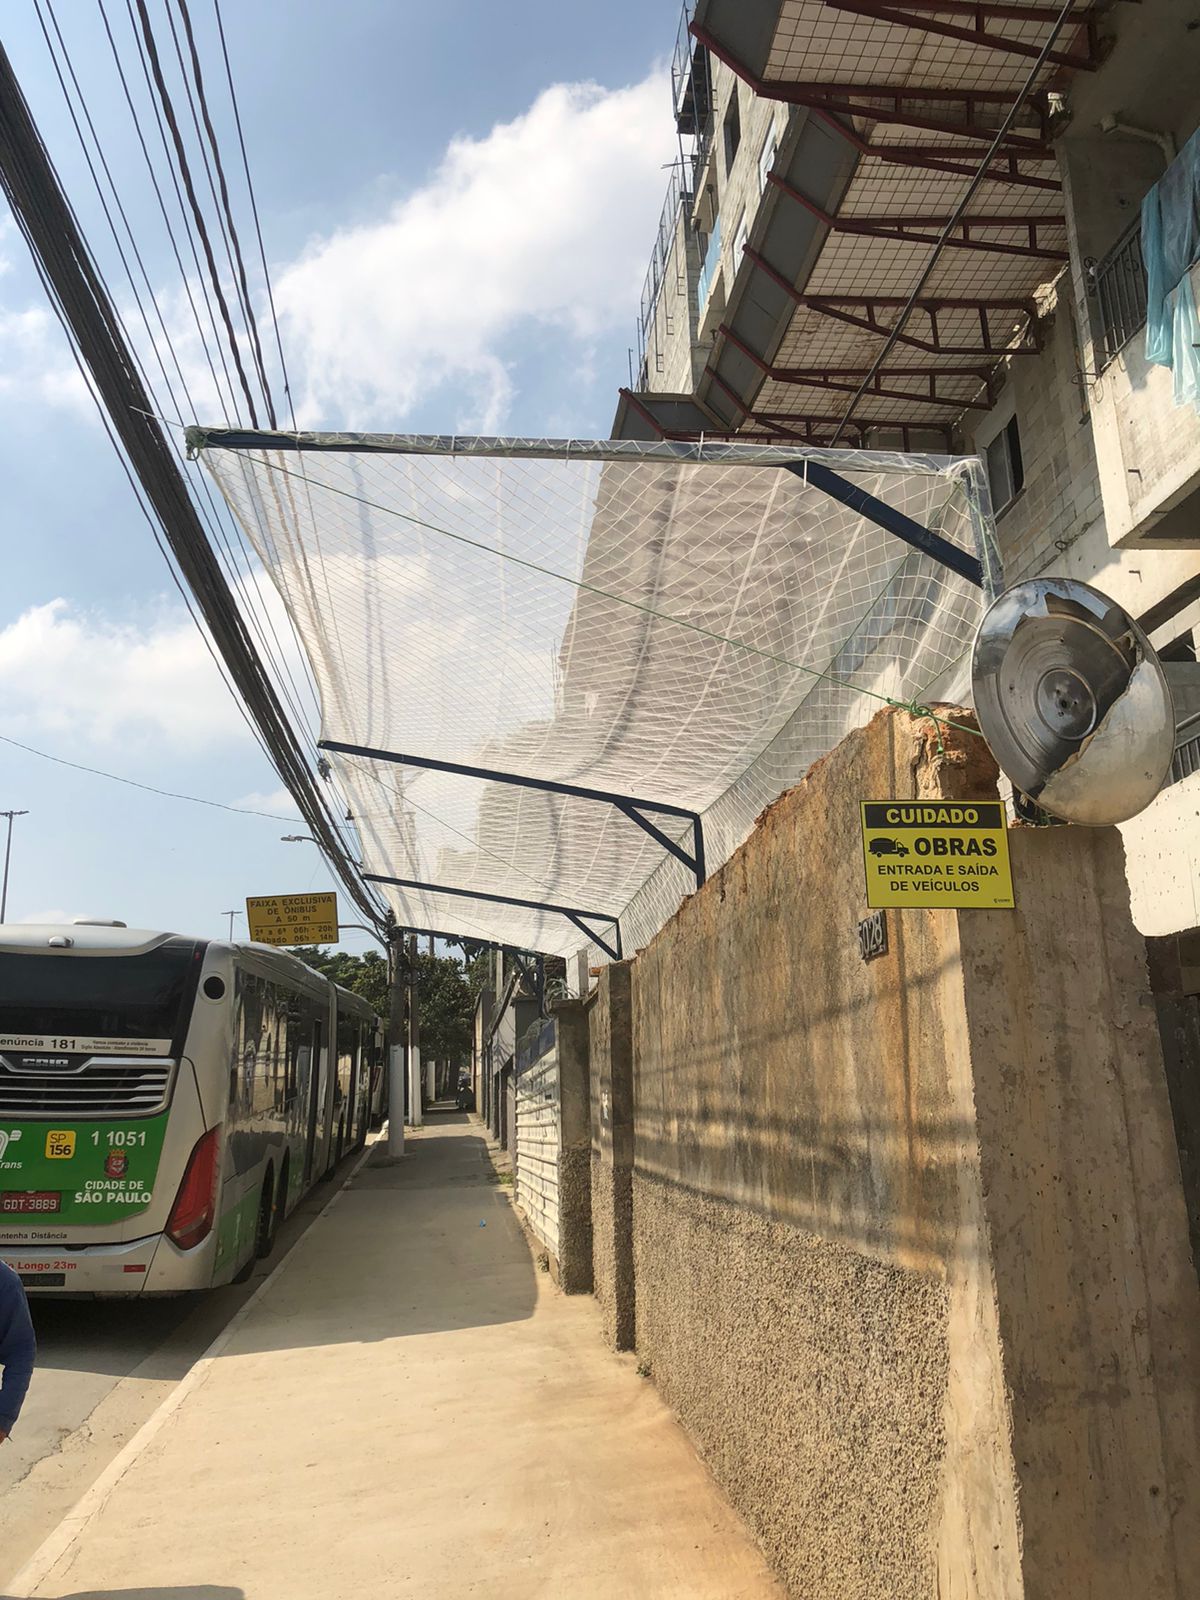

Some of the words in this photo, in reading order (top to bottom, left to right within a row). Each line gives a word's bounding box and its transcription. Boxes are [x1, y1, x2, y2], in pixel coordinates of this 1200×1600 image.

[886, 808, 979, 824] CUIDADO
[914, 837, 997, 857] OBRAS
[878, 864, 943, 876] ENTRADA
[946, 865, 954, 875] E
[958, 862, 999, 876] SAÍDA
[890, 881, 909, 892] DE
[912, 878, 980, 892] VEÍCULOS
[250, 899, 277, 908] FAIXA
[282, 896, 332, 906] EXCLUSIVA
[284, 905, 317, 914] ÔNIBUS
[0, 1037, 44, 1047] enúncia
[51, 1039, 76, 1050] 181
[50, 1133, 66, 1144] SP
[91, 1131, 100, 1146] 1
[106, 1131, 146, 1146] 1051
[50, 1144, 72, 1156] 156
[85, 1180, 126, 1190] CIDADE
[129, 1180, 144, 1190] DE
[74, 1190, 103, 1204] SÃO
[106, 1192, 152, 1204] PAULO
[31, 1231, 67, 1239] Distância
[17, 1261, 50, 1271] Longo
[53, 1261, 77, 1270] 23m
